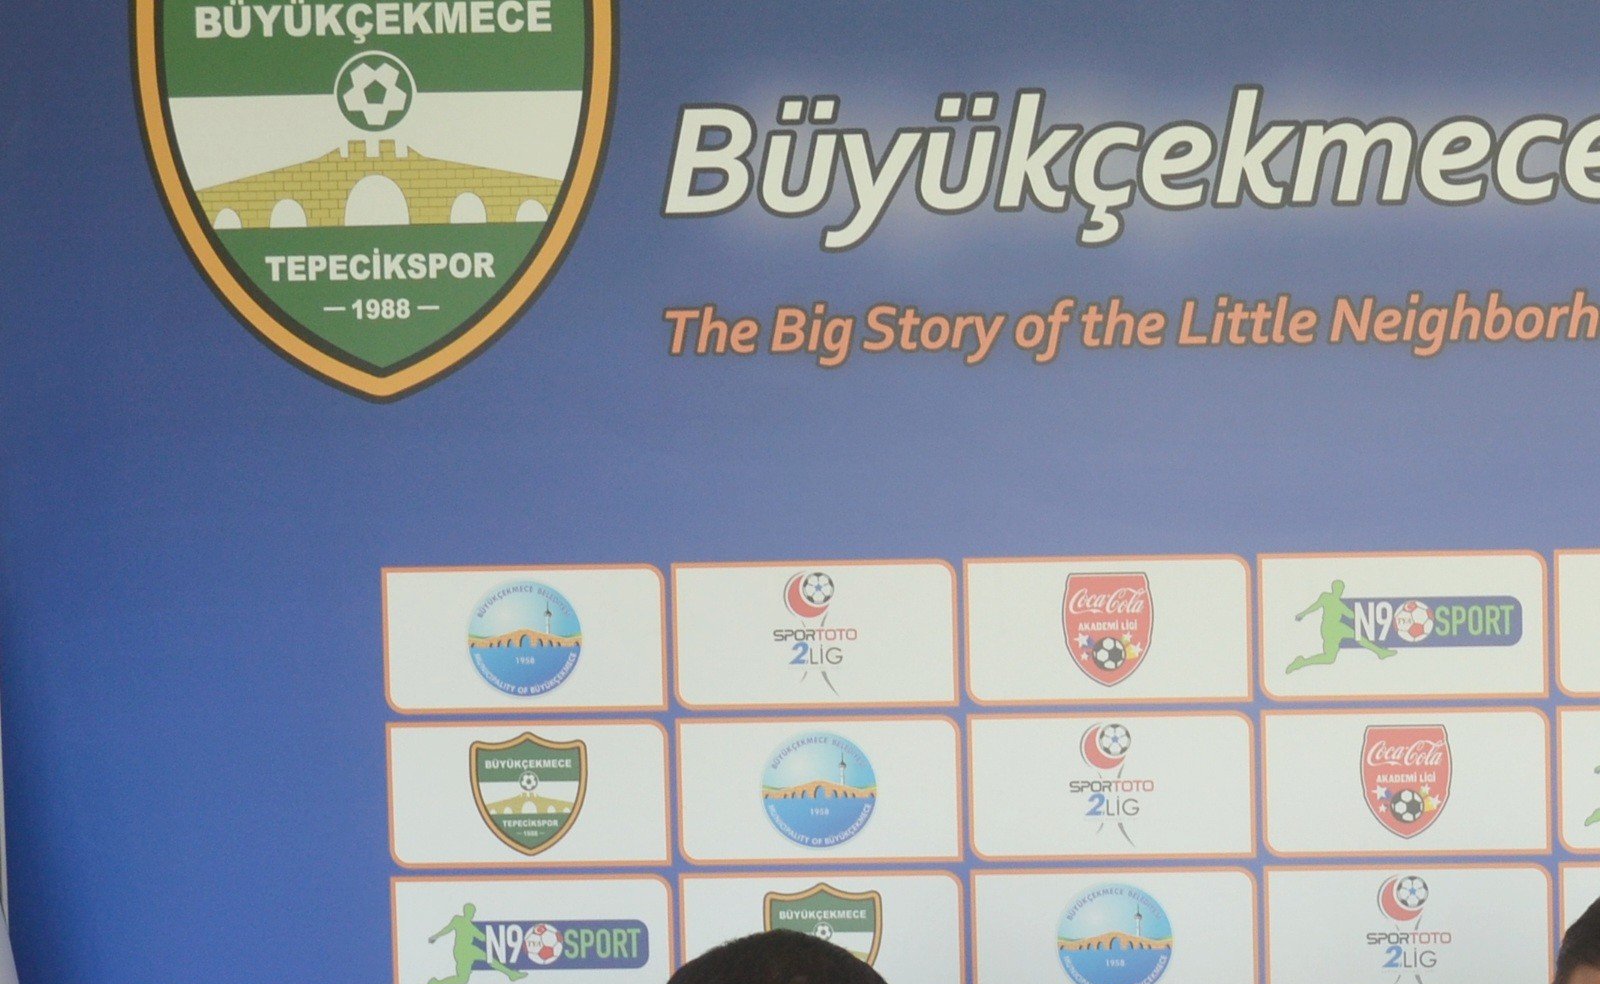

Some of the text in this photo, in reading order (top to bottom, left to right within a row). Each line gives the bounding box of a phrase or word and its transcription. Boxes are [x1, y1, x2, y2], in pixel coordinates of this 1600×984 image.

[195, 0, 553, 43] BÜYÜKÇEKMECE
[265, 248, 496, 282] TEPECİKSPOR
[351, 298, 411, 321] 1988
[664, 305, 757, 355] The
[770, 302, 853, 367] Big
[864, 299, 1003, 363] Story
[1015, 296, 1071, 361] of
[1080, 296, 1165, 349] the
[1176, 292, 1317, 346] Little
[1435, 605, 1514, 636] SPORT
[564, 928, 640, 959] SPORT
